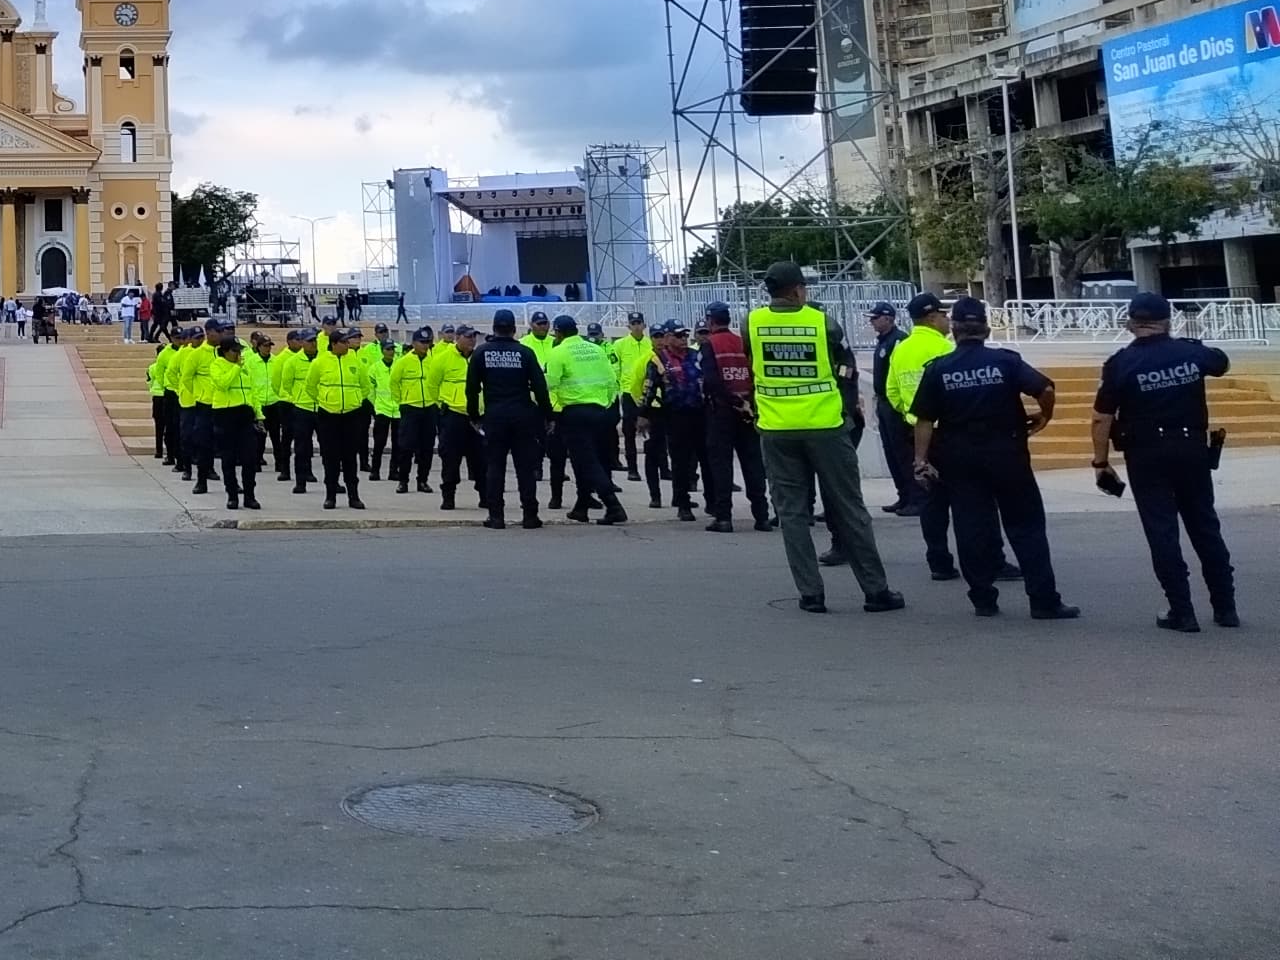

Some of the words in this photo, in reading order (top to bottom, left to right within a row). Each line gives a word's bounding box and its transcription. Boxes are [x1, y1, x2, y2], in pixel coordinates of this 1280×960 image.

[1110, 44, 1136, 60] Centro
[1136, 34, 1170, 53] Pastoral
[1113, 62, 1139, 82] San
[1142, 52, 1177, 76] Juan
[1179, 43, 1198, 66] de
[1200, 36, 1235, 60] Dios
[764, 344, 814, 352] SEGURIDAD
[773, 351, 809, 360] VIAL
[766, 366, 816, 376] GNB
[942, 365, 1003, 383] POLICÍA
[1136, 362, 1200, 384] POLICÍA
[945, 380, 980, 391] ESTADAL
[981, 377, 1004, 385] ZULIA
[1140, 379, 1180, 392] ESTADAL
[1181, 374, 1201, 385] ZULIA
